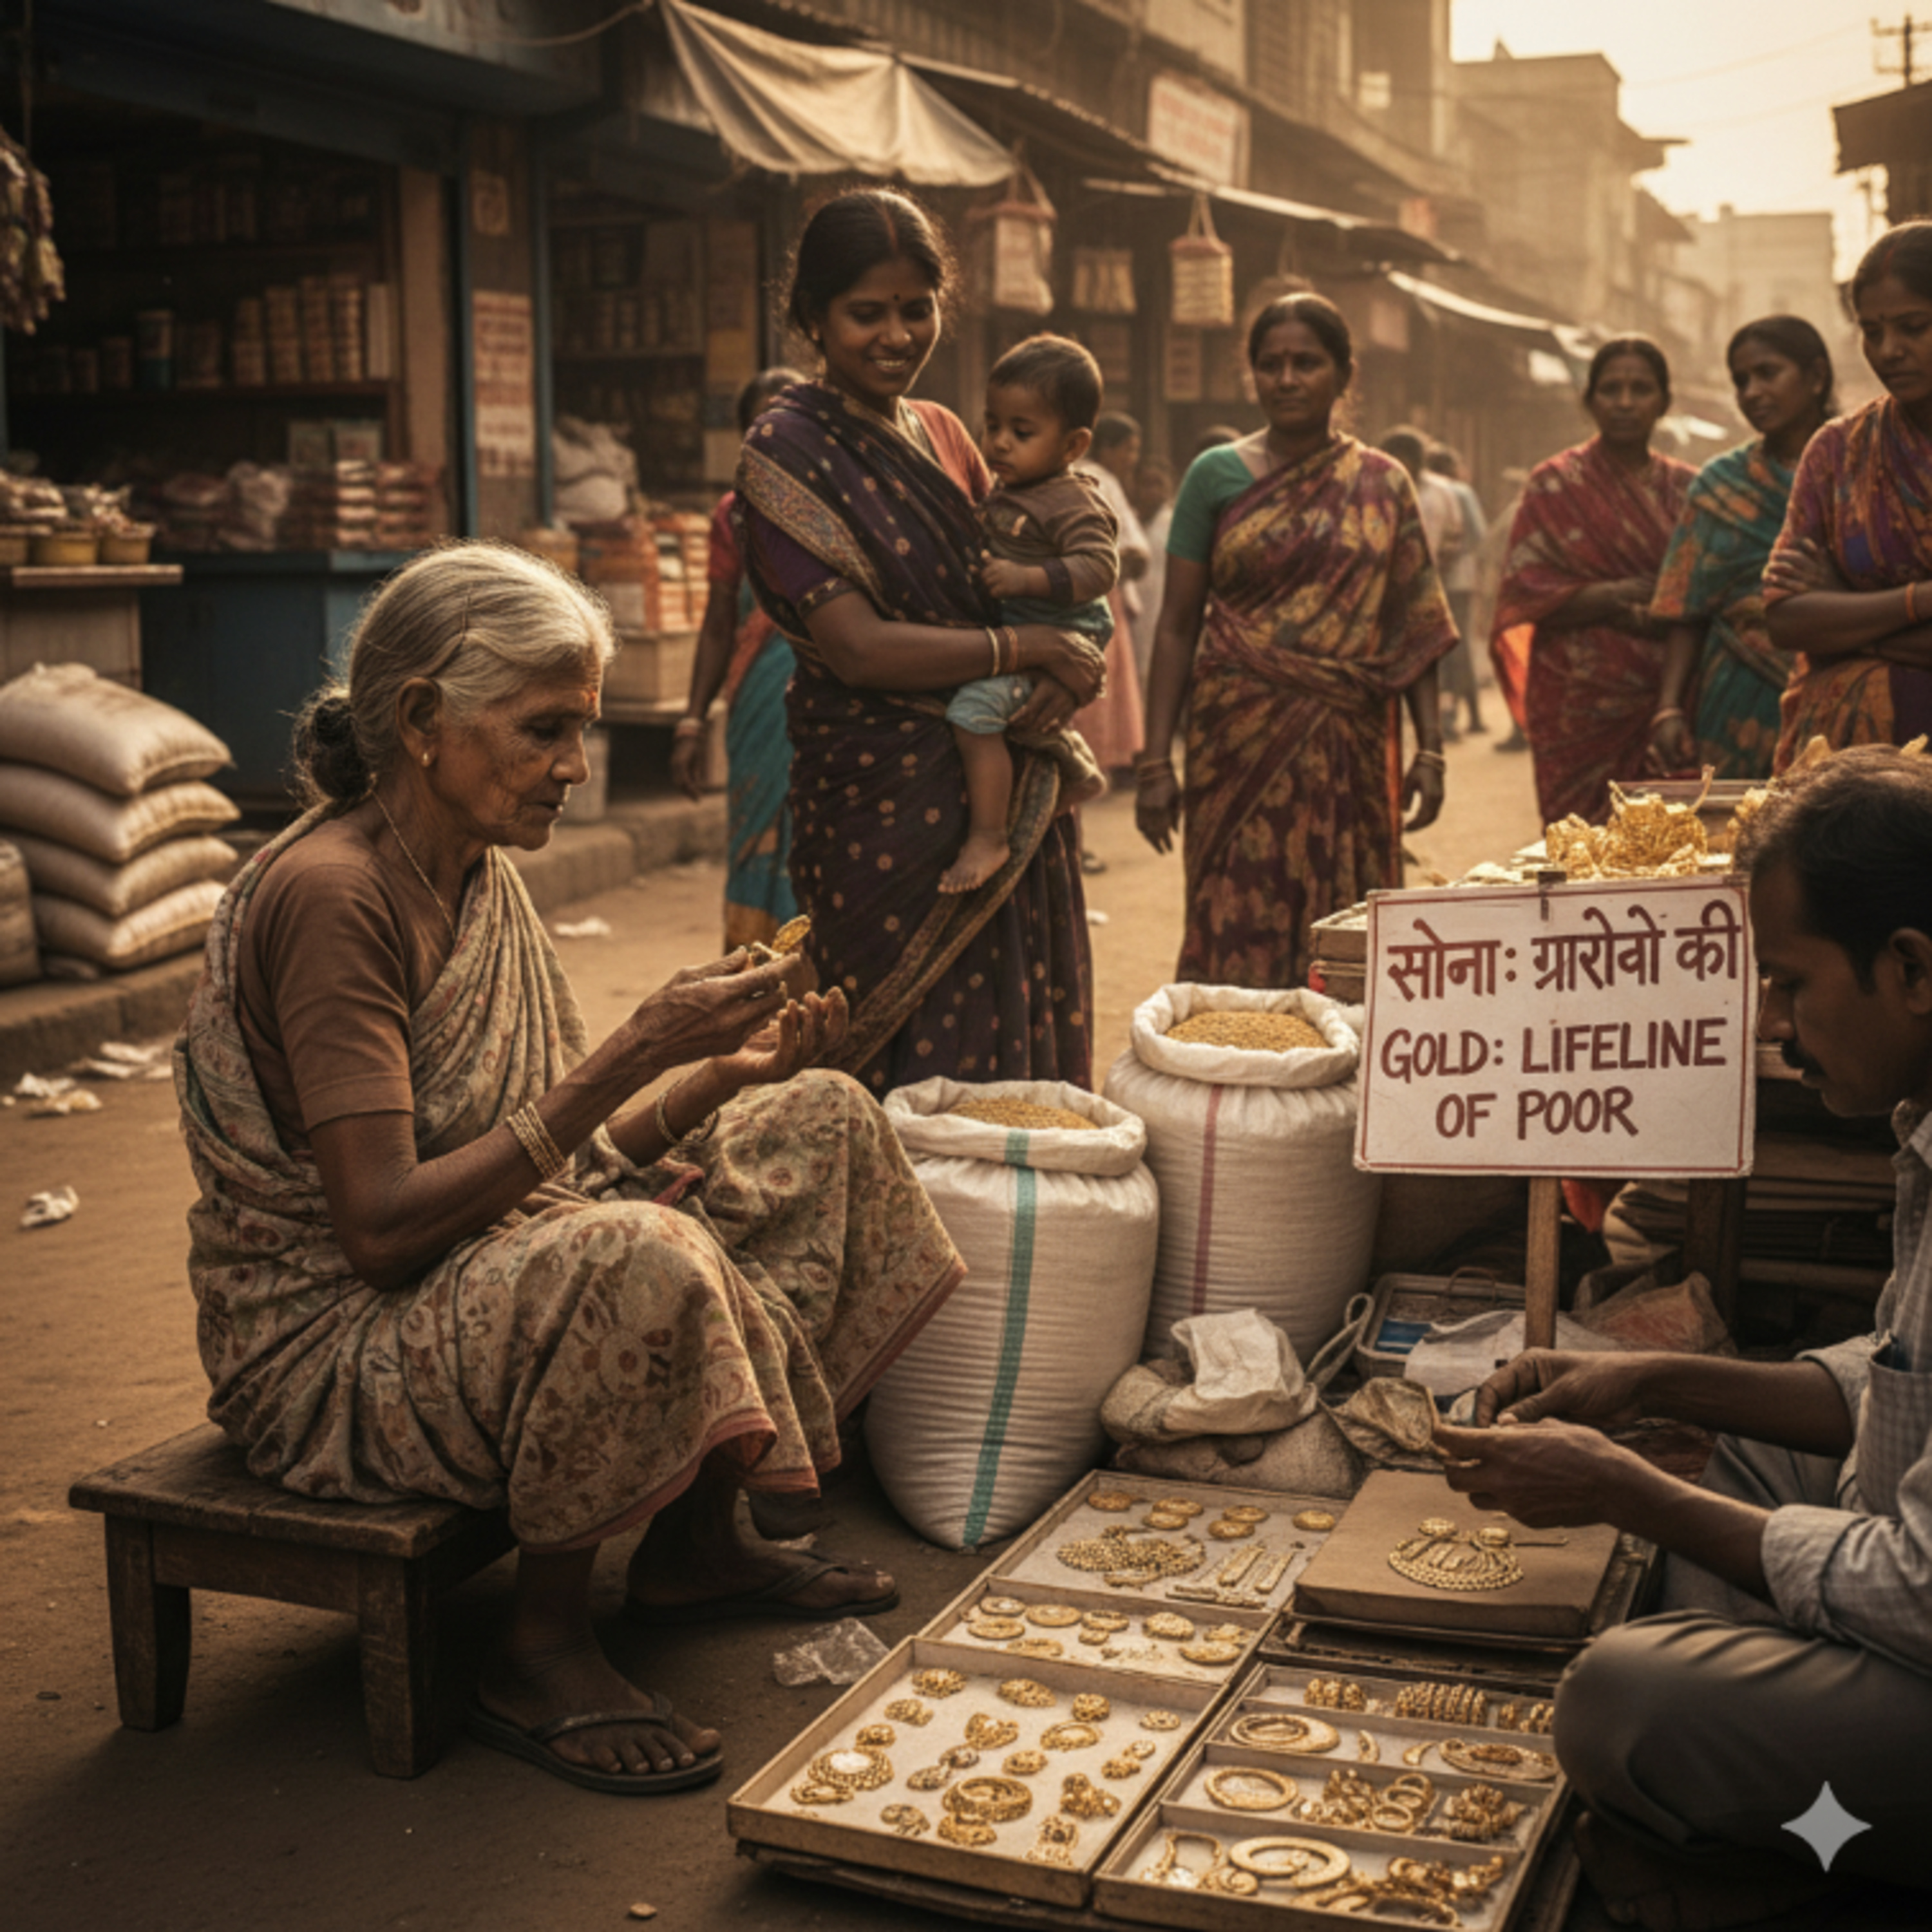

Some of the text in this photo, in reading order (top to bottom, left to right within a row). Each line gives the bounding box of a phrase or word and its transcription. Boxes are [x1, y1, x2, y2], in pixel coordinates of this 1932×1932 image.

[1674, 900, 1741, 981] की
[1380, 1018, 1727, 1084] GOLD: LIFELINE
[1435, 1086, 1639, 1141] OF POOR
